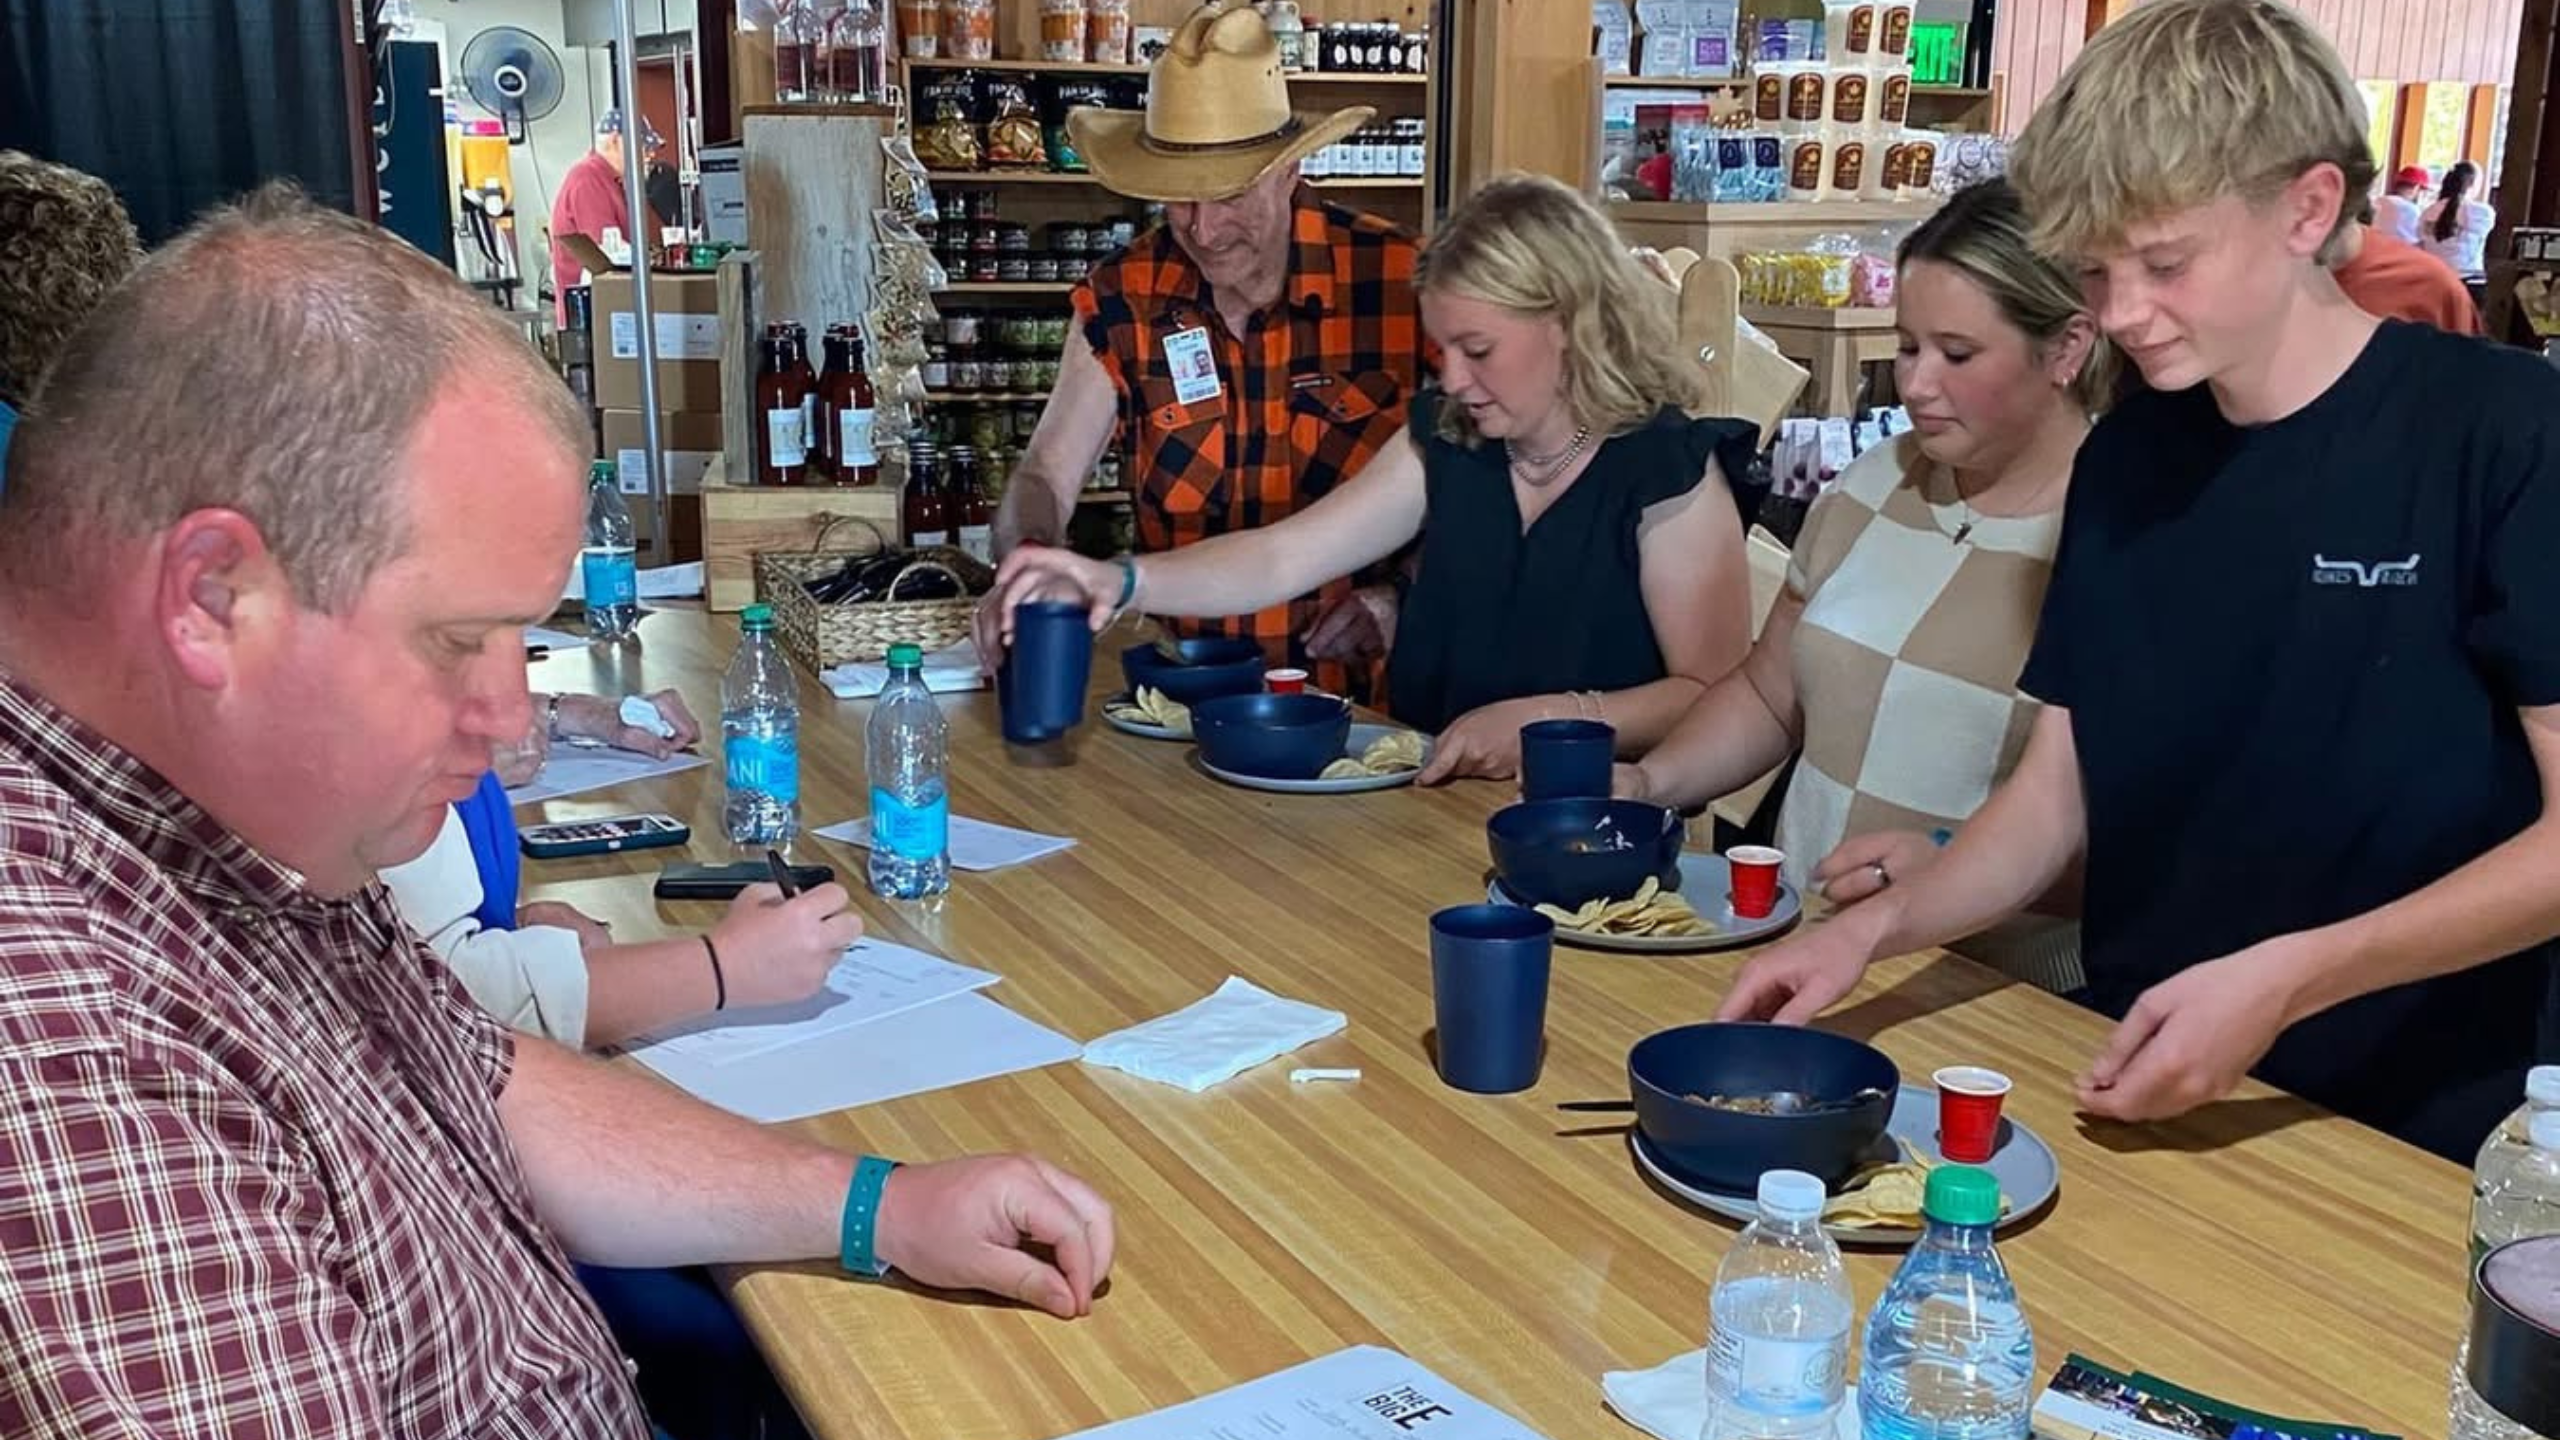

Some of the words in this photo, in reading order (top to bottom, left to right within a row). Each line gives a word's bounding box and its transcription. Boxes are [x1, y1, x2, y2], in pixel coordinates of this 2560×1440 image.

[1908, 27, 1955, 81] XIT
[1363, 1393, 1408, 1418] BIG
[1393, 1404, 1454, 1431] E
[1392, 1386, 1434, 1409] THE
